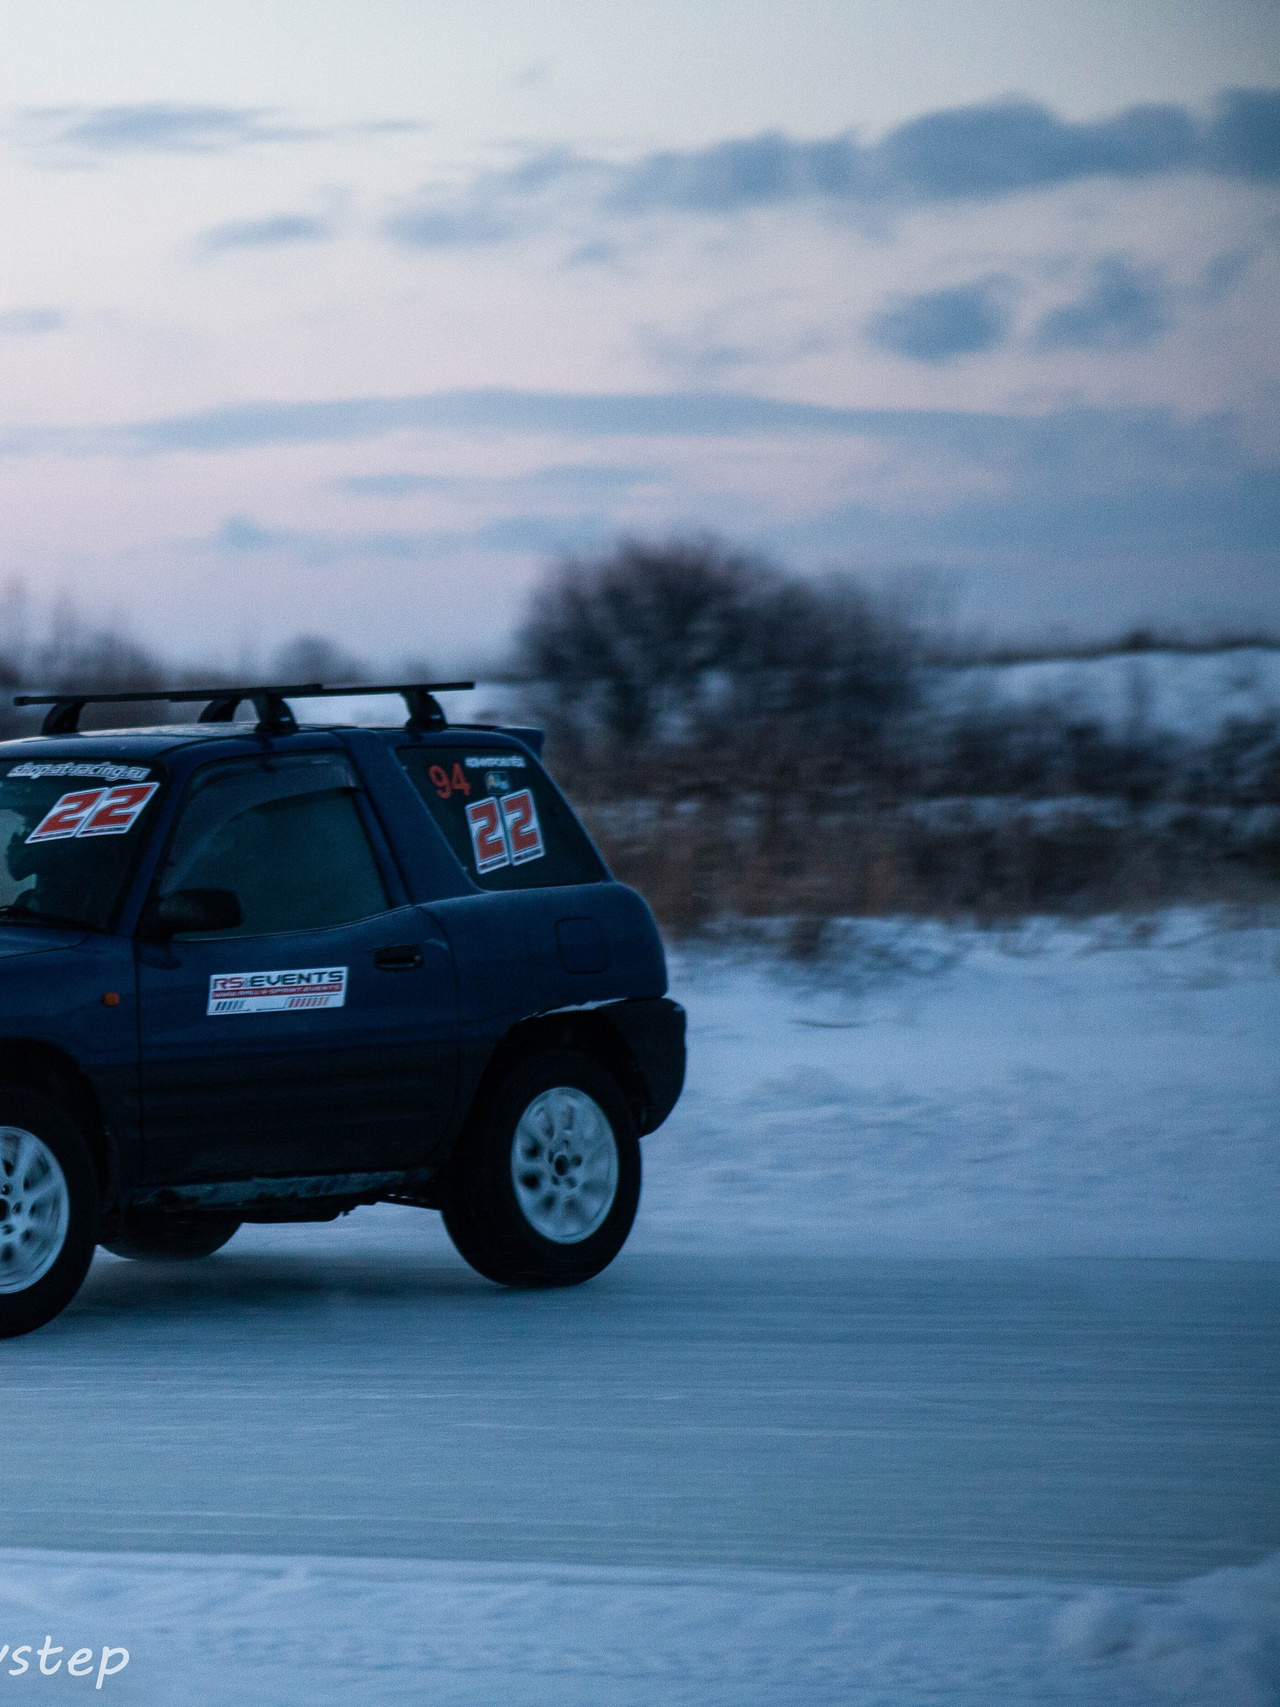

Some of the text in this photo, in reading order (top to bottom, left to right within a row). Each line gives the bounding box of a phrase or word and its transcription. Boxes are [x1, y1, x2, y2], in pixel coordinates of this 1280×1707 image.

[7, 762, 151, 781] shop.at-racing.ru
[428, 762, 472, 799] 94
[36, 785, 154, 834] 22
[469, 793, 540, 861] 22
[250, 971, 343, 986] EVENTS
